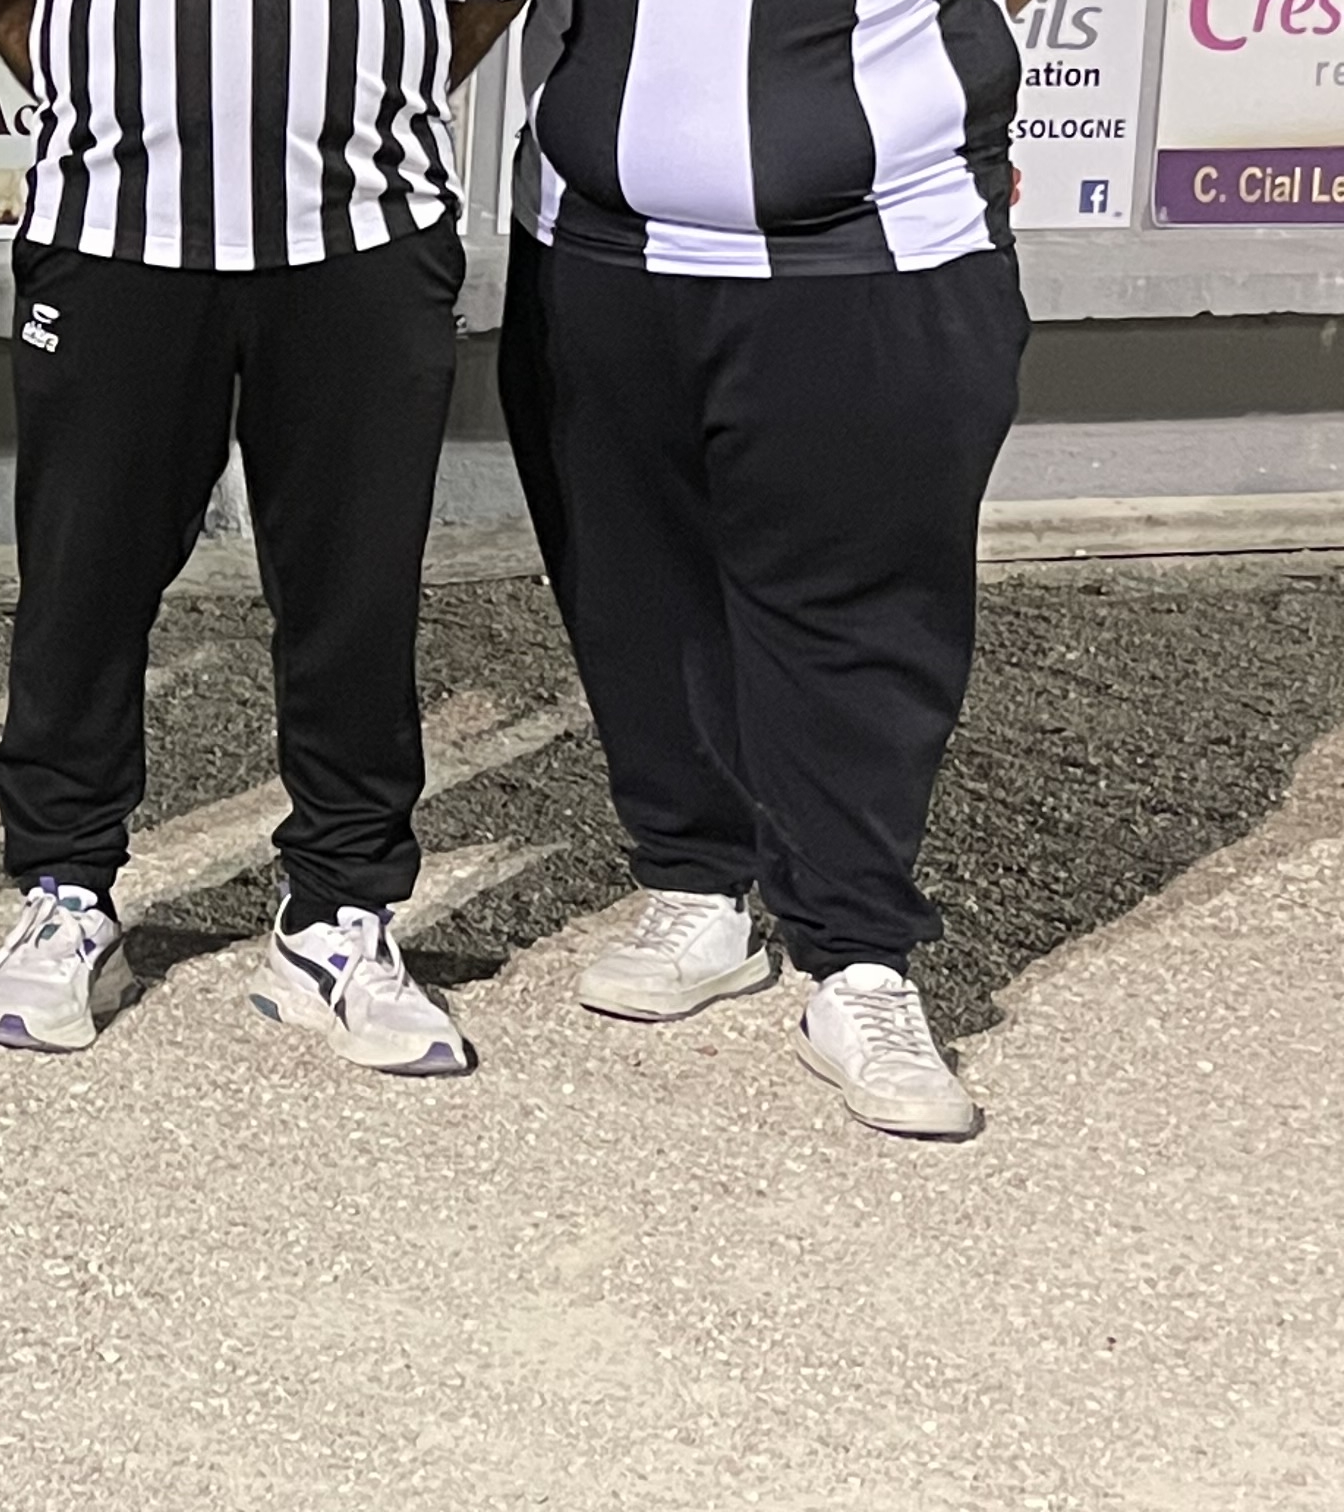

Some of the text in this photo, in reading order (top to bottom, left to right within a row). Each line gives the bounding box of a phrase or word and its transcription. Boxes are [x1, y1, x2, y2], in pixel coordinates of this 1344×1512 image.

[1025, 61, 1100, 87] ation
[1194, 166, 1226, 203] C.
[1239, 166, 1302, 203] Cial
